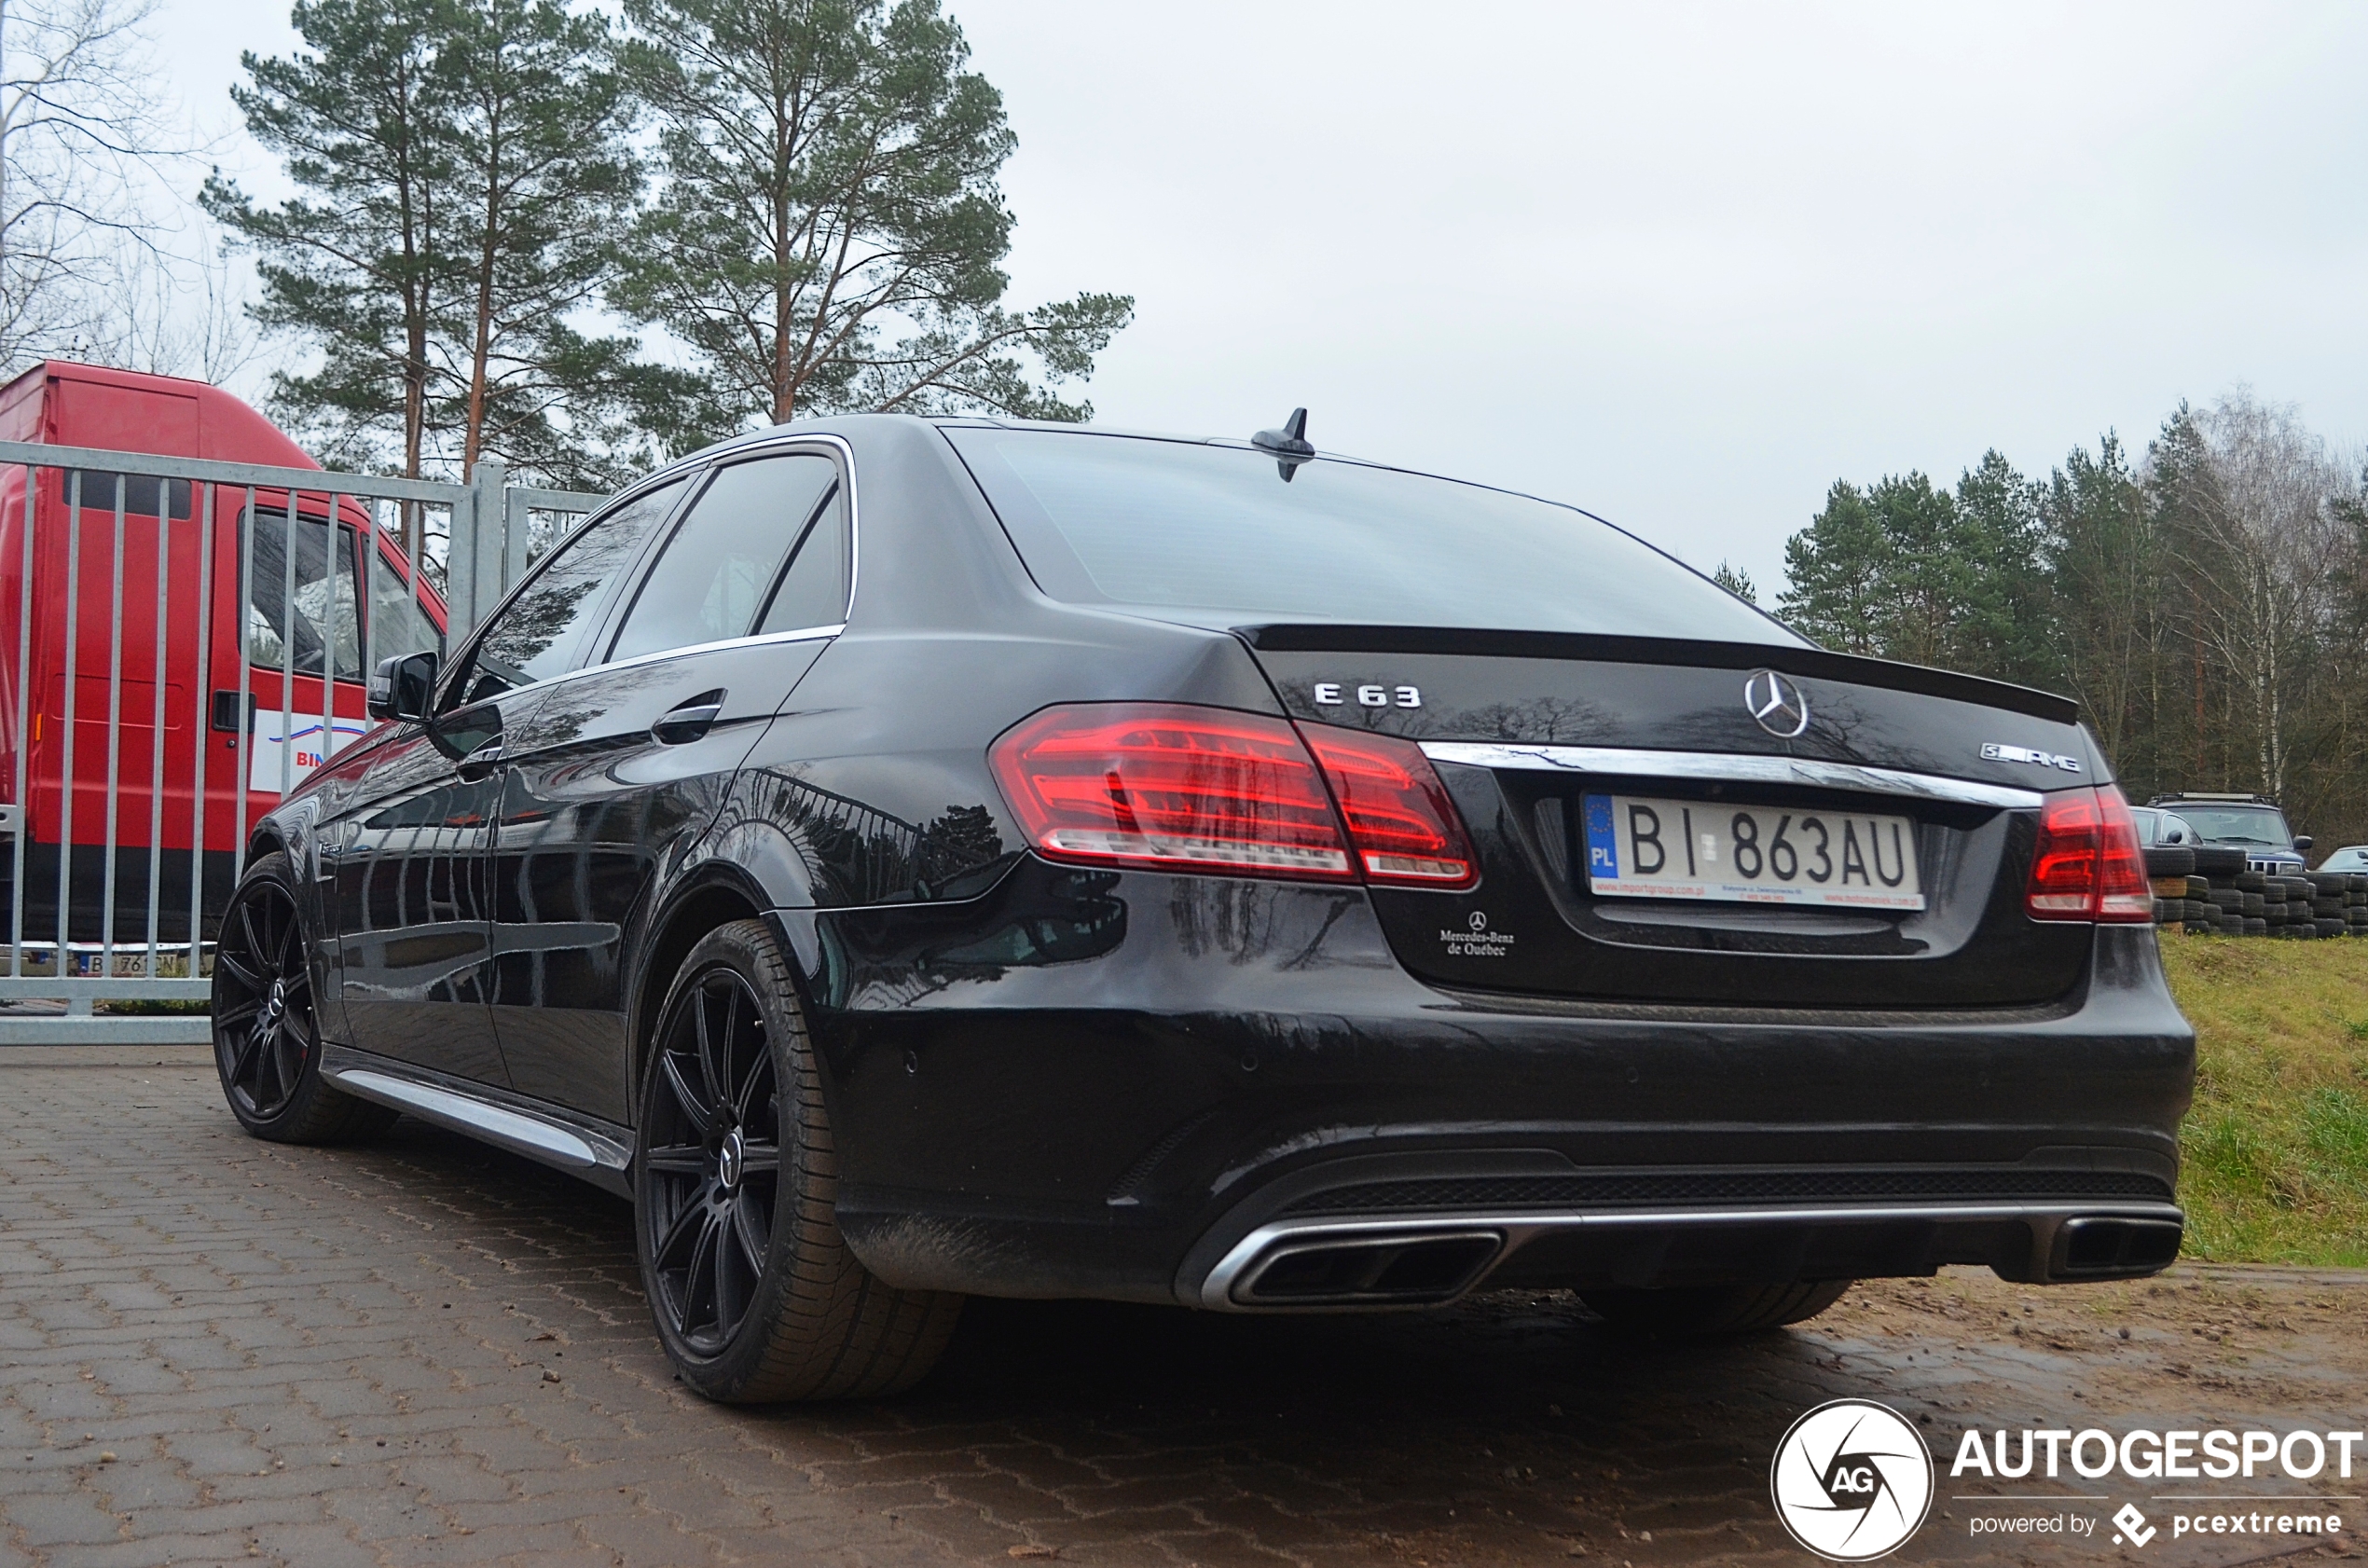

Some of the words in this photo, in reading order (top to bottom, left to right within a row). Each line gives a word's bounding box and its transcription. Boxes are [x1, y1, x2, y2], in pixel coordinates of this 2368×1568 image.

[1314, 682, 1343, 705] E
[1357, 685, 1422, 708] 63
[2026, 750, 2081, 773] AMG
[1628, 804, 1697, 876] BI
[1730, 811, 1904, 887] 863AU
[1591, 847, 1614, 866] PL
[1594, 882, 1705, 898] www.importgroup.com.pl
[1440, 929, 1514, 943] Mercedes-Benz
[1447, 942, 1462, 955] de
[1464, 942, 1506, 956] Québec
